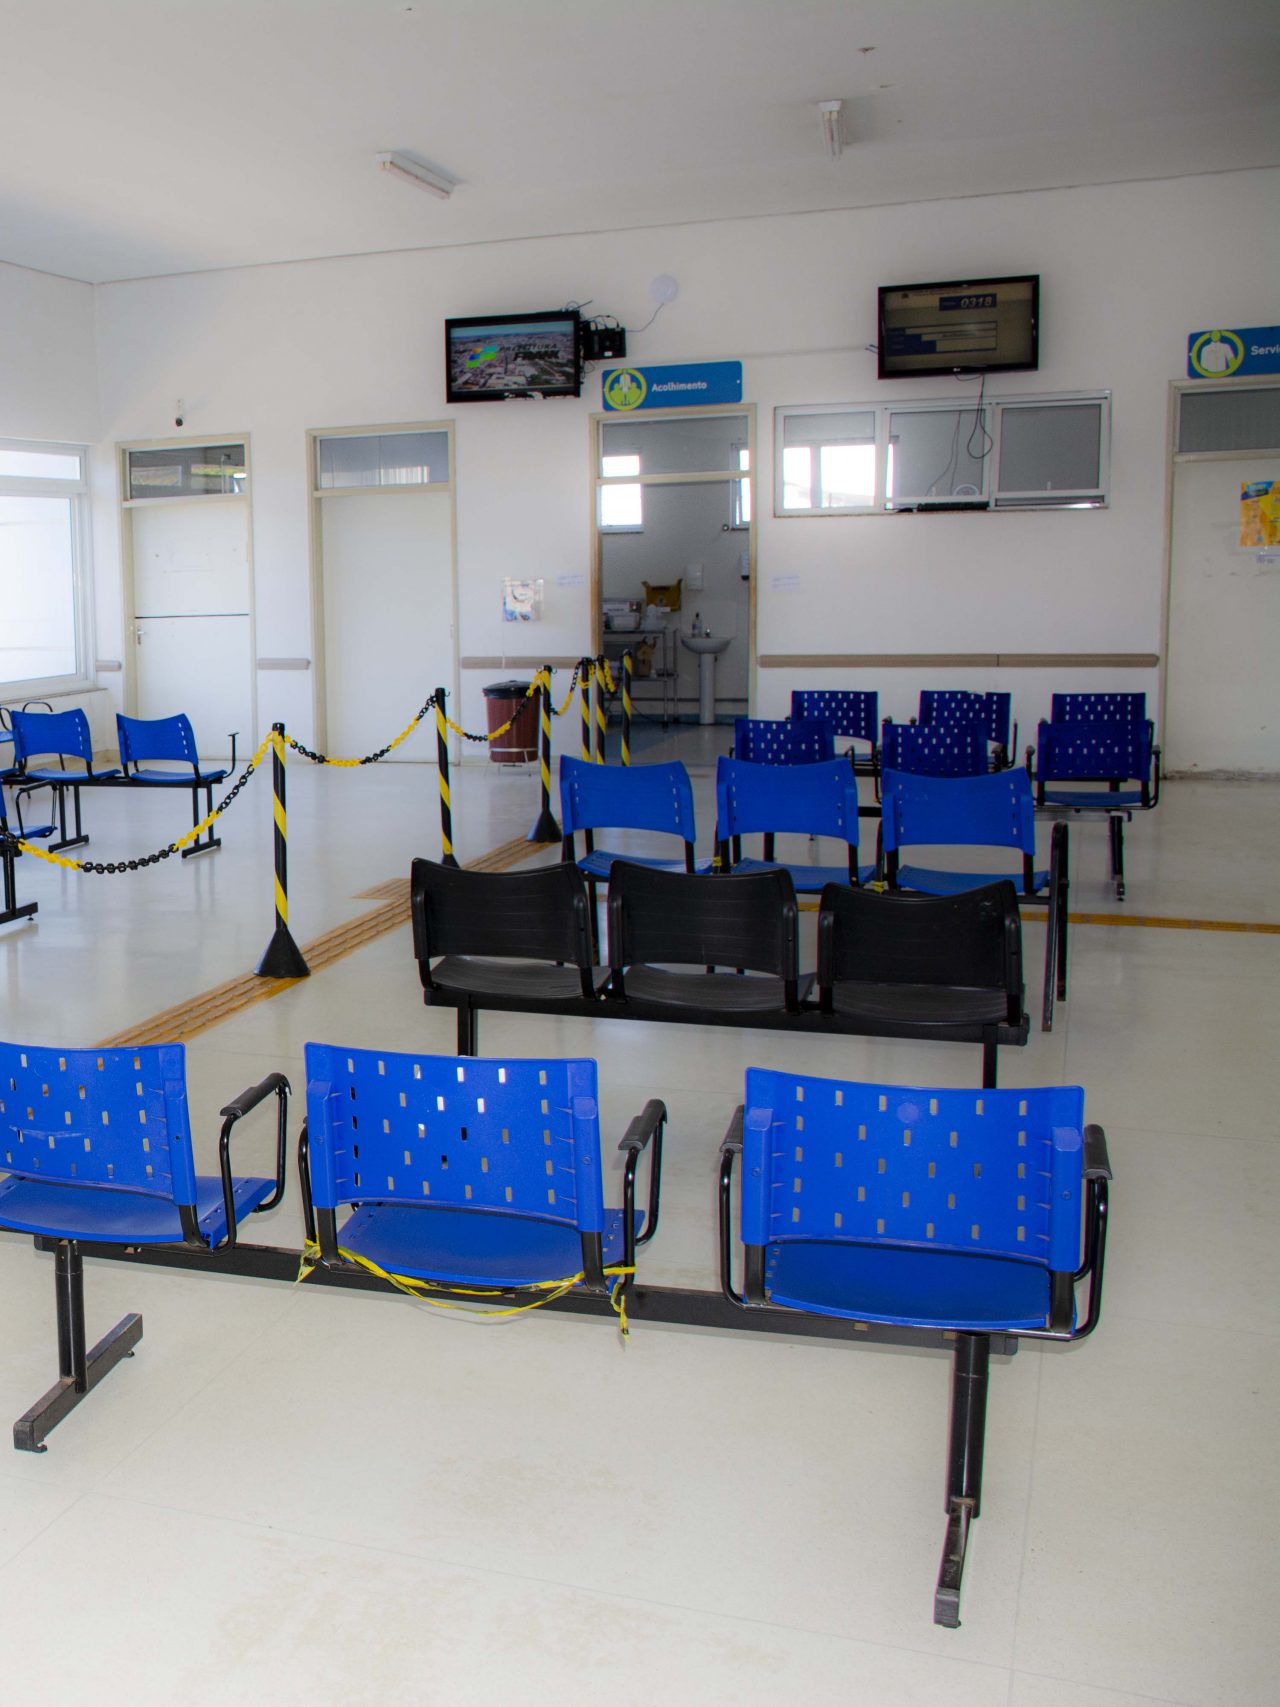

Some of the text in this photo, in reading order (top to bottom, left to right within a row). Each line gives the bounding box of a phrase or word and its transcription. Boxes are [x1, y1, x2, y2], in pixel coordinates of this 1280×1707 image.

[960, 296, 992, 309] 0318
[1250, 344, 1280, 356] Servi
[651, 381, 708, 393] Acolhimento
